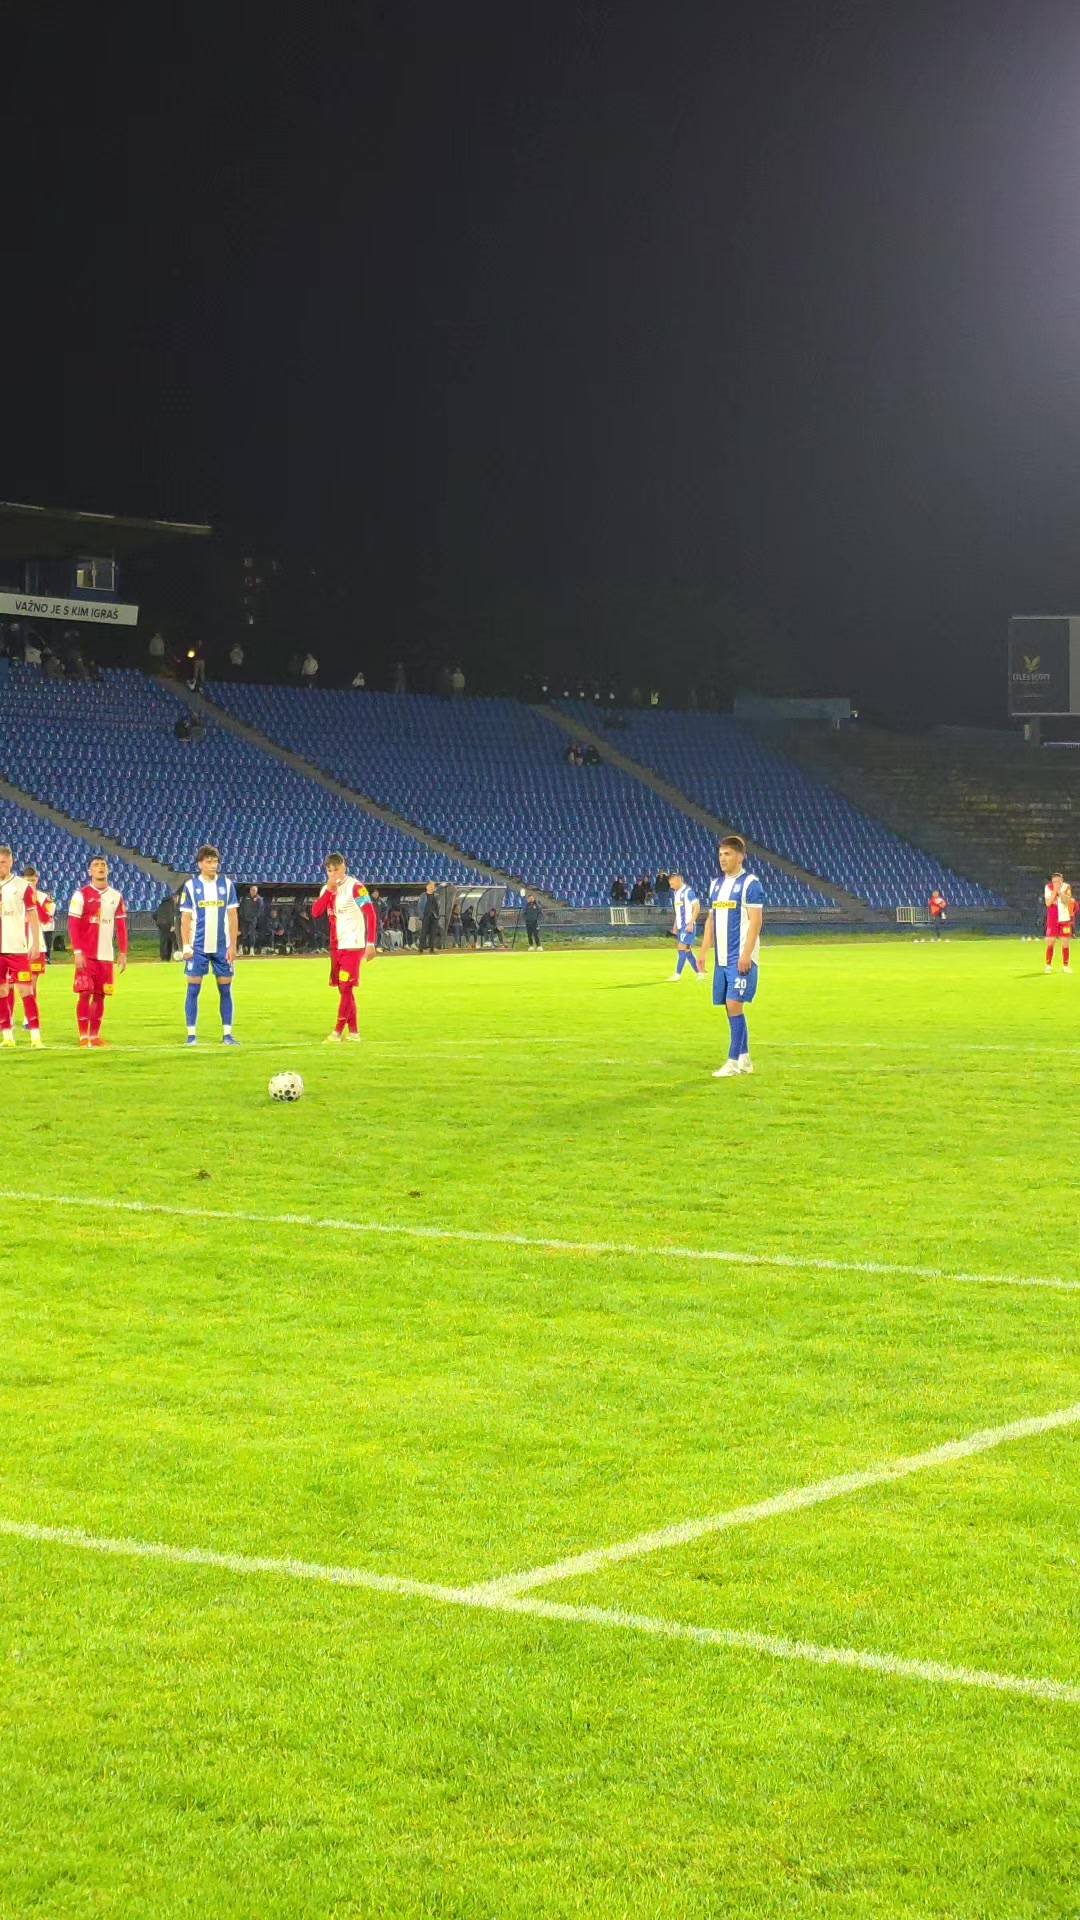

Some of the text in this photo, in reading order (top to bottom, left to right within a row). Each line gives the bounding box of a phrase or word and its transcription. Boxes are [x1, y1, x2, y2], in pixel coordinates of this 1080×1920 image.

[15, 600, 119, 620] VAŽNO JE S KIM IGRAŠ
[734, 978, 747, 988] 20
